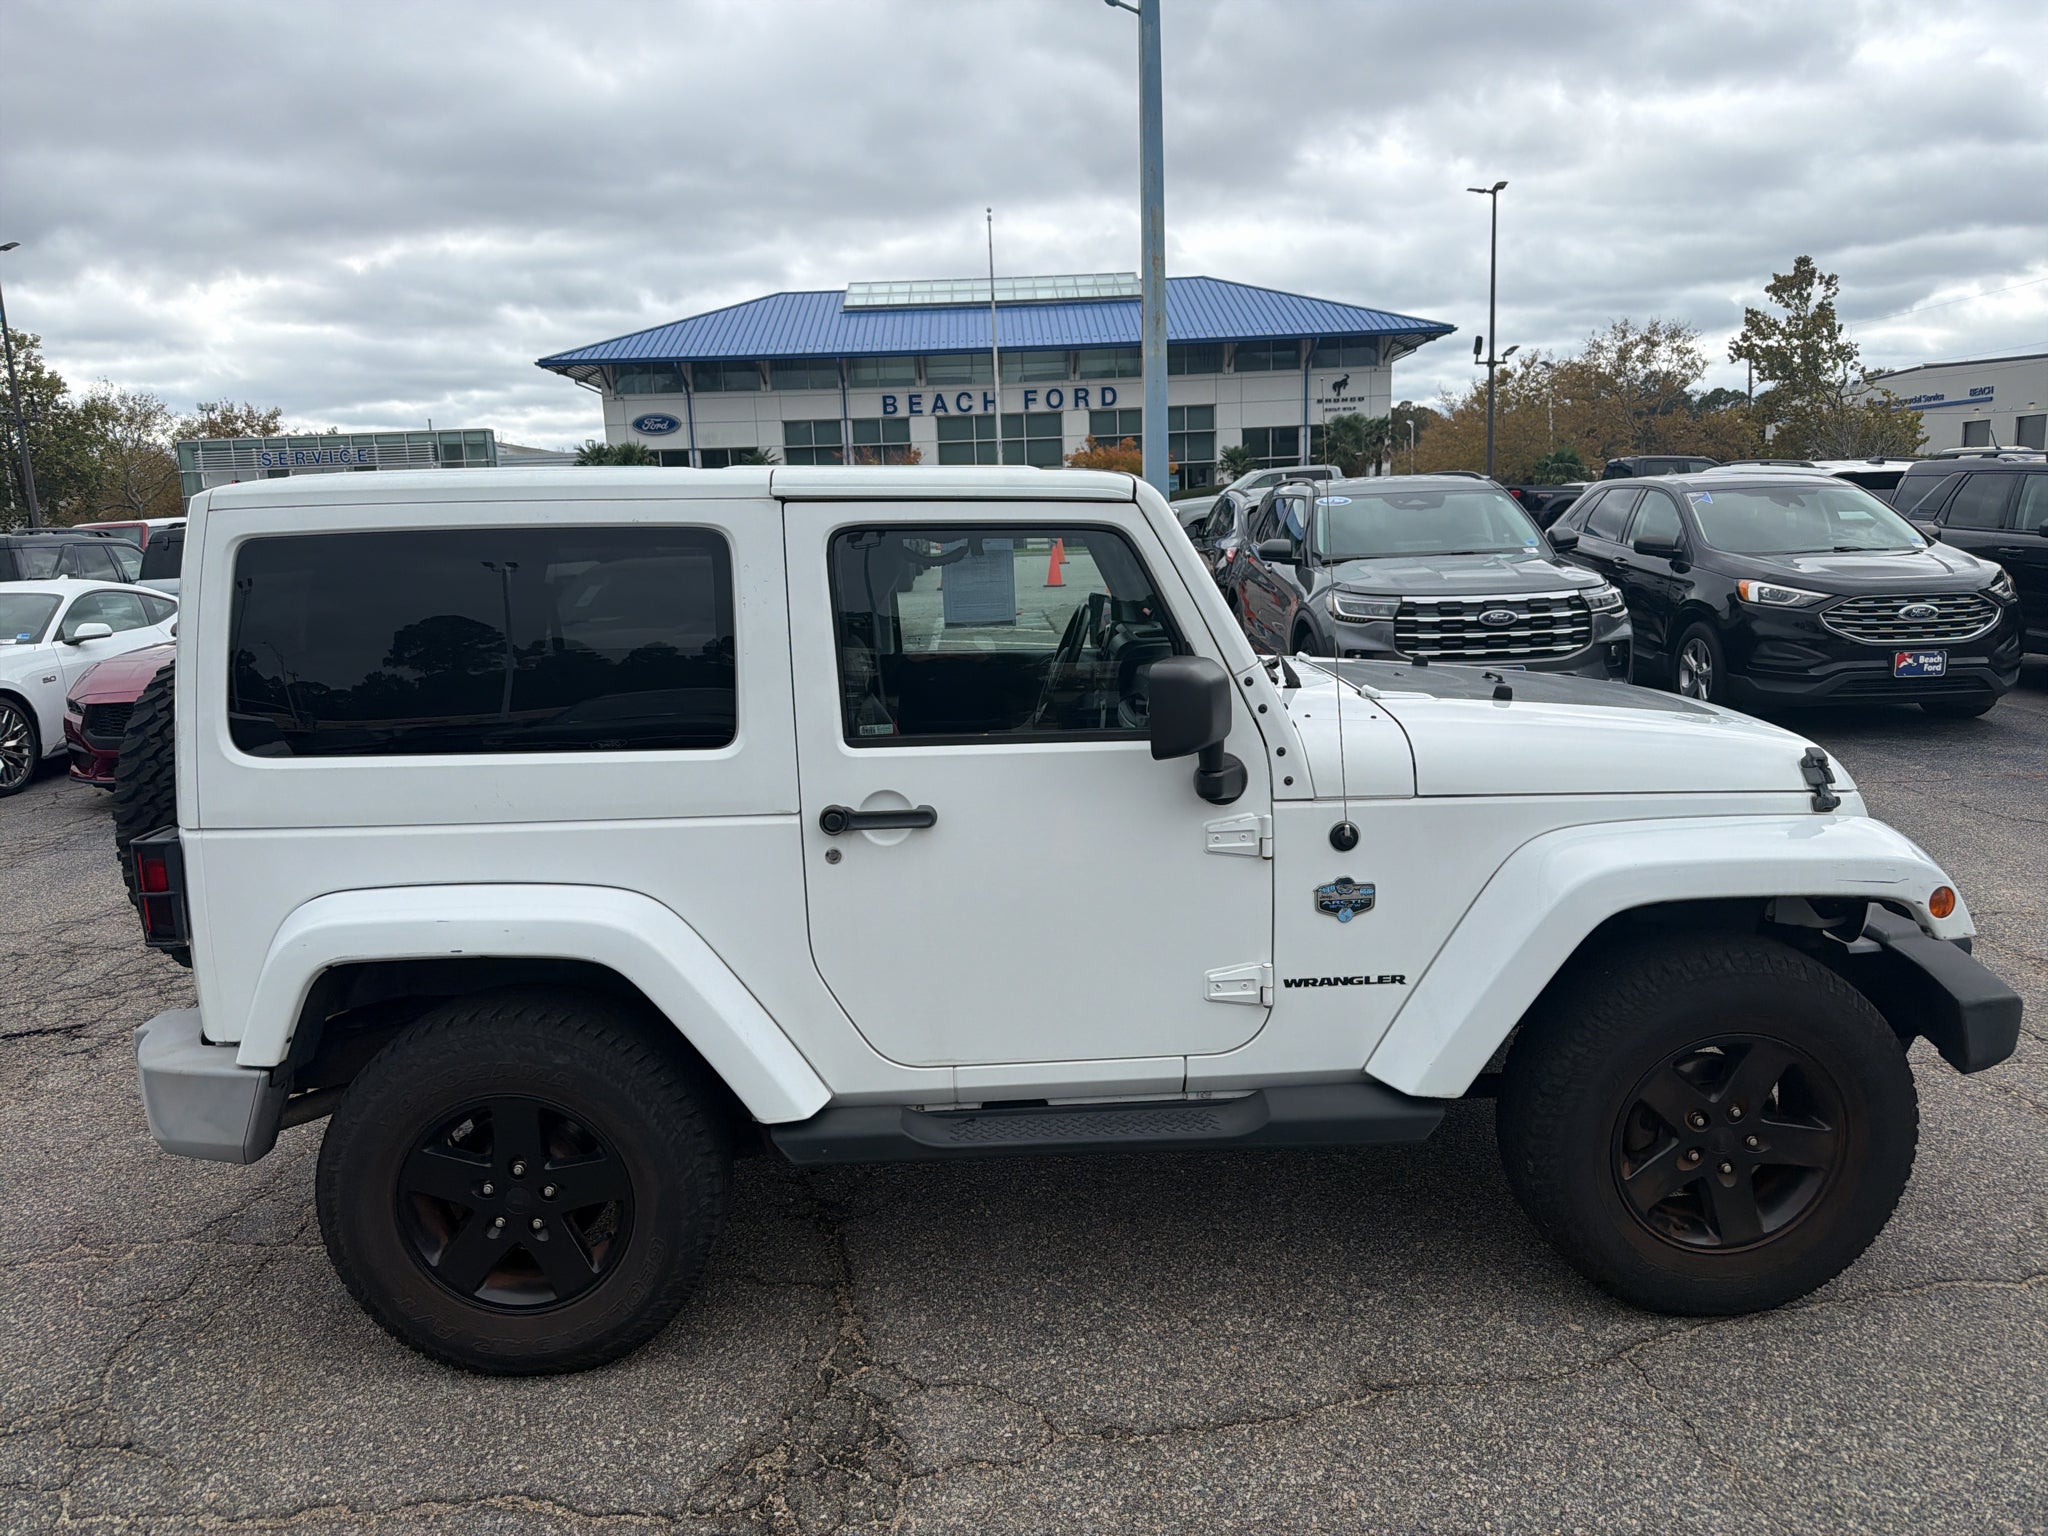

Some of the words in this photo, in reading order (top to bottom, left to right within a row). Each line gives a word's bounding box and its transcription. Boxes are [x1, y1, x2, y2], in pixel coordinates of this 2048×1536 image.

[1968, 386, 1994, 396] BEACH
[882, 391, 996, 415] BEACH
[1023, 386, 1118, 410] FORD
[642, 418, 669, 430] Ford
[261, 449, 368, 467] SERVICE
[1908, 607, 1932, 617] Ford
[1919, 655, 1943, 664] Beach
[1923, 663, 1942, 672] Ford
[1283, 974, 1407, 988] WRANGLER
